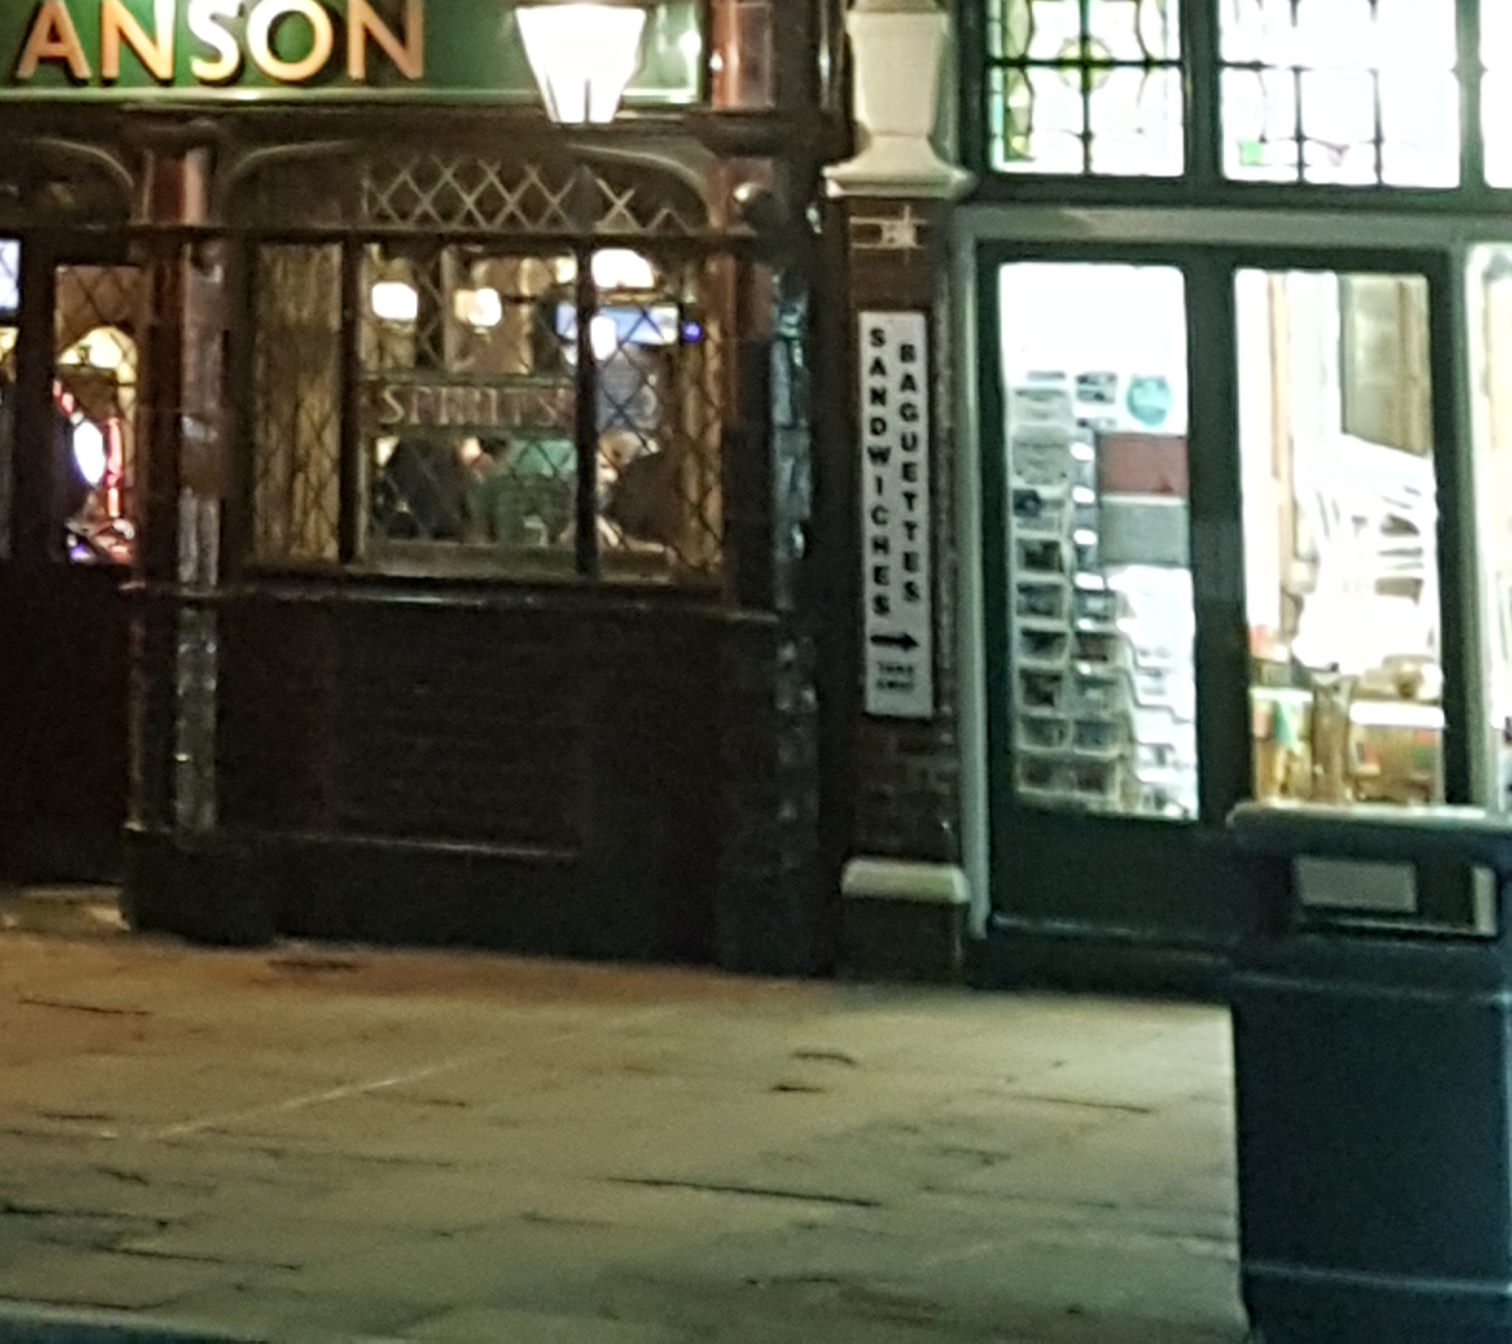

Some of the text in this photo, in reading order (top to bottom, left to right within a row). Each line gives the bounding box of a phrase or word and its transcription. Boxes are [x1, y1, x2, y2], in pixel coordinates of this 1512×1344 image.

[378, 384, 567, 427] SPIRITS
[867, 327, 892, 616] SANDWICHES
[900, 343, 921, 602] BAGUETTES
